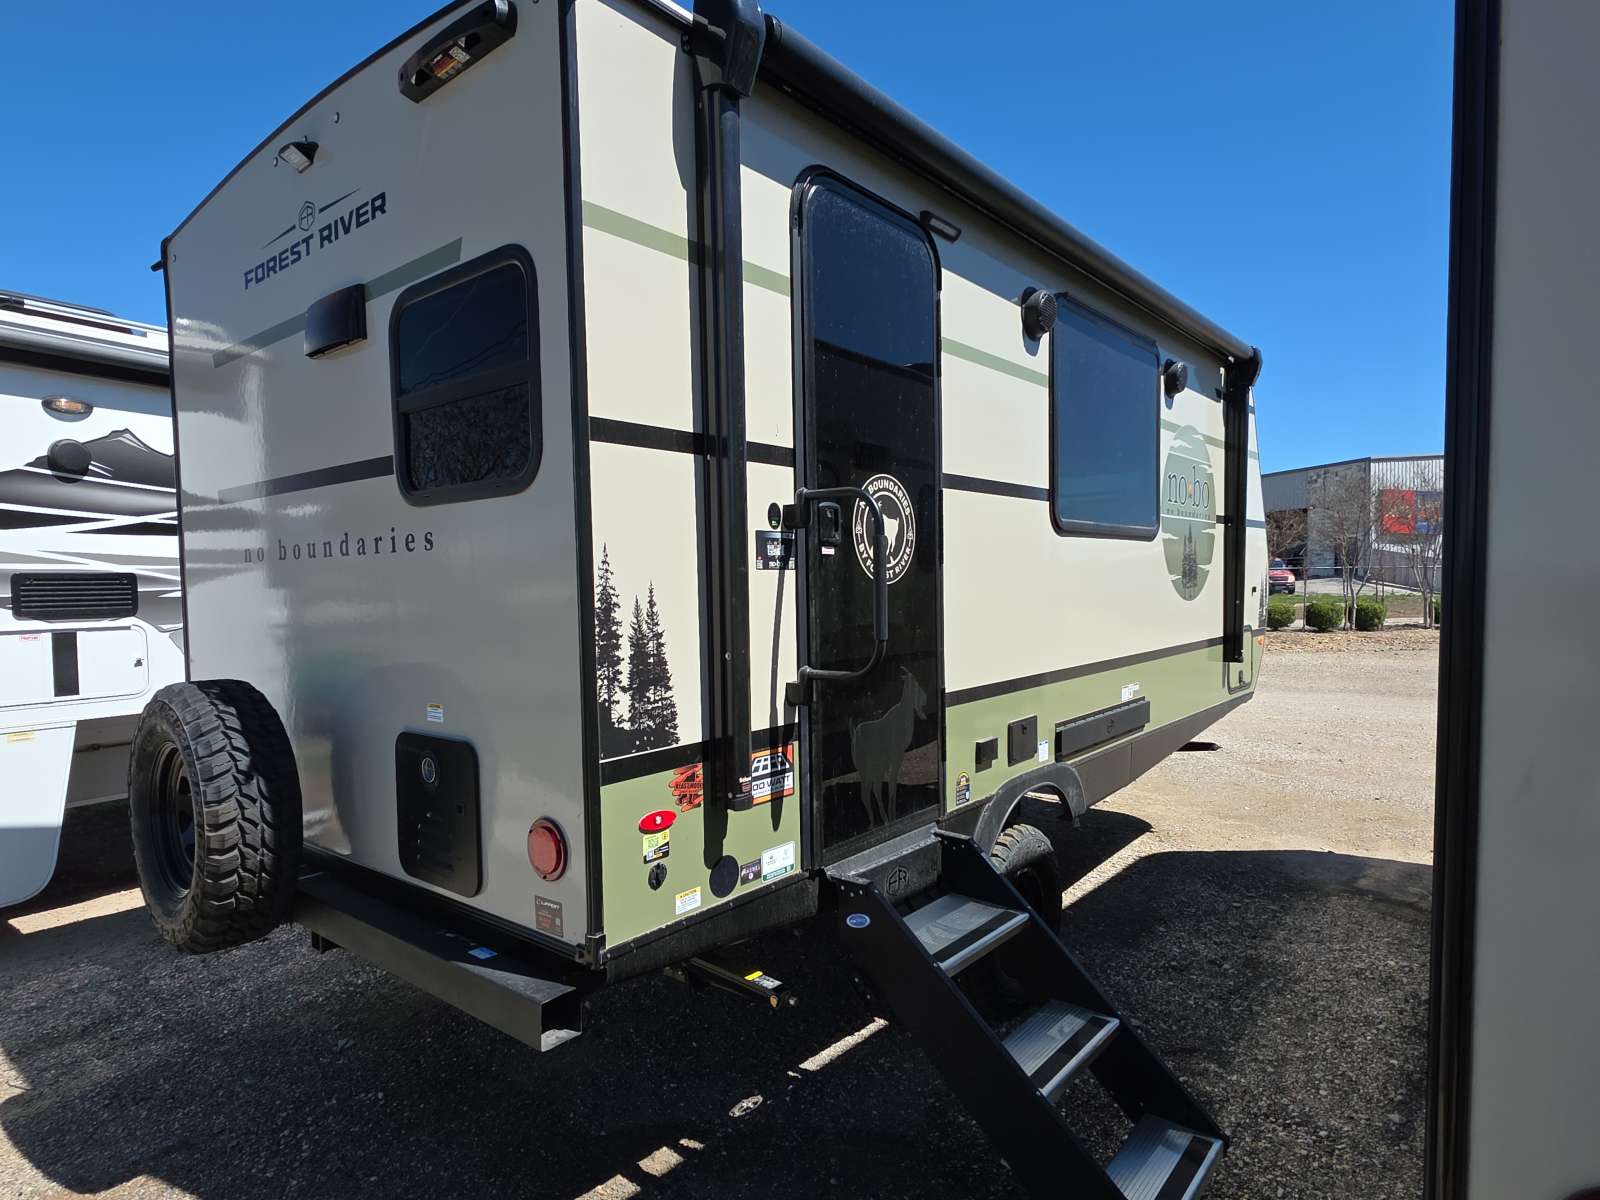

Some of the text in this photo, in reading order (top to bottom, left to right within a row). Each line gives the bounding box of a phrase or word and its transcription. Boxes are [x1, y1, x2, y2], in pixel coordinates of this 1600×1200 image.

[244, 191, 387, 290] FOREST RIVER
[867, 479, 911, 516] BOUNDARIES
[243, 526, 434, 563] no boundaries
[858, 543, 869, 560] BY
[894, 546, 912, 574] RIVER
[766, 772, 792, 788] WATT
